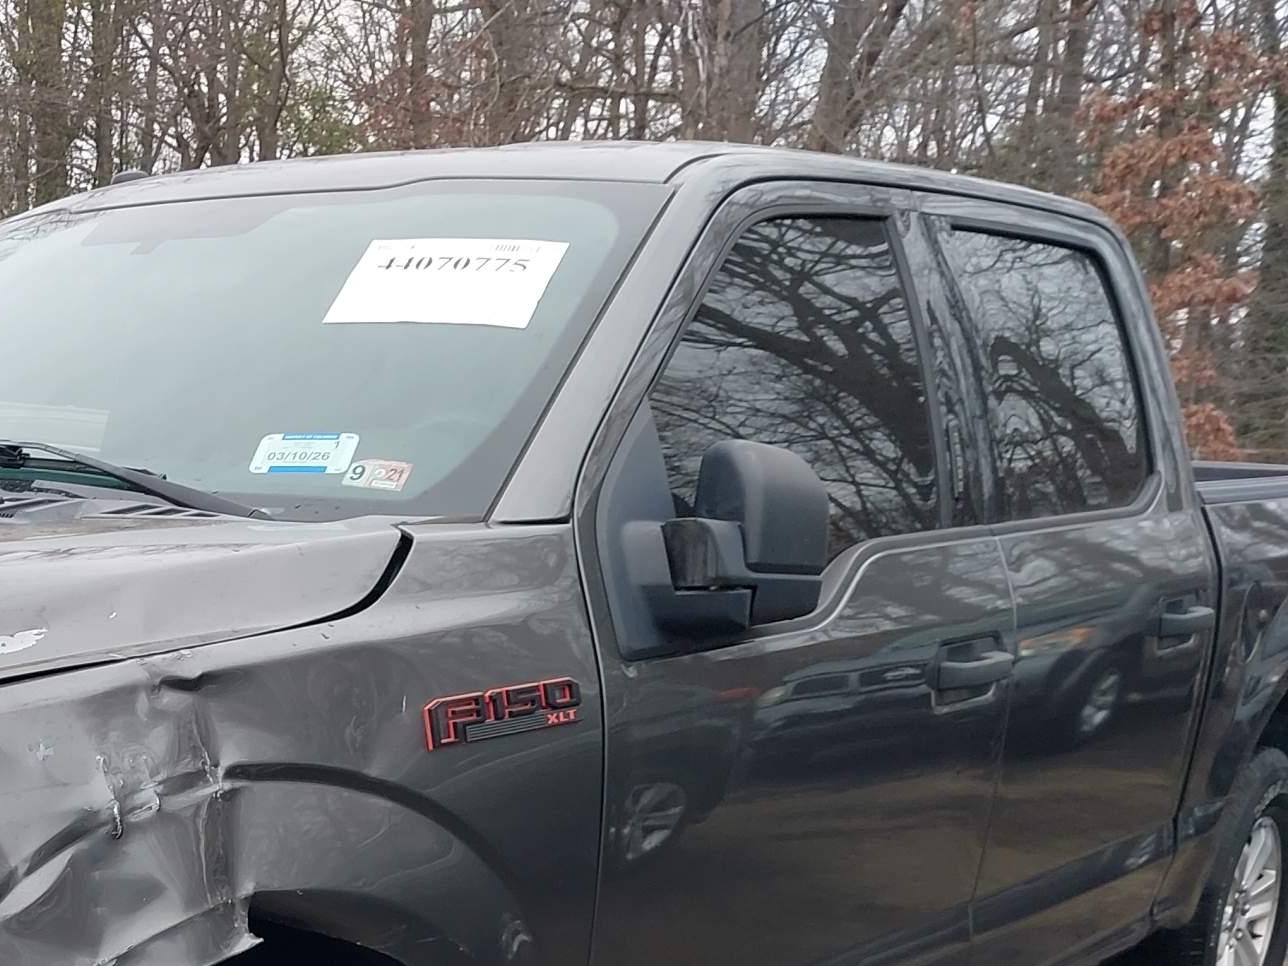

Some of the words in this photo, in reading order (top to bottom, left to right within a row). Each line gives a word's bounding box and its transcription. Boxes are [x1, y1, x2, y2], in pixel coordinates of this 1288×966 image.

[266, 451, 332, 462] 03/10/26
[349, 464, 365, 481] 9
[423, 676, 583, 753] F150
[546, 708, 578, 725] XLT
